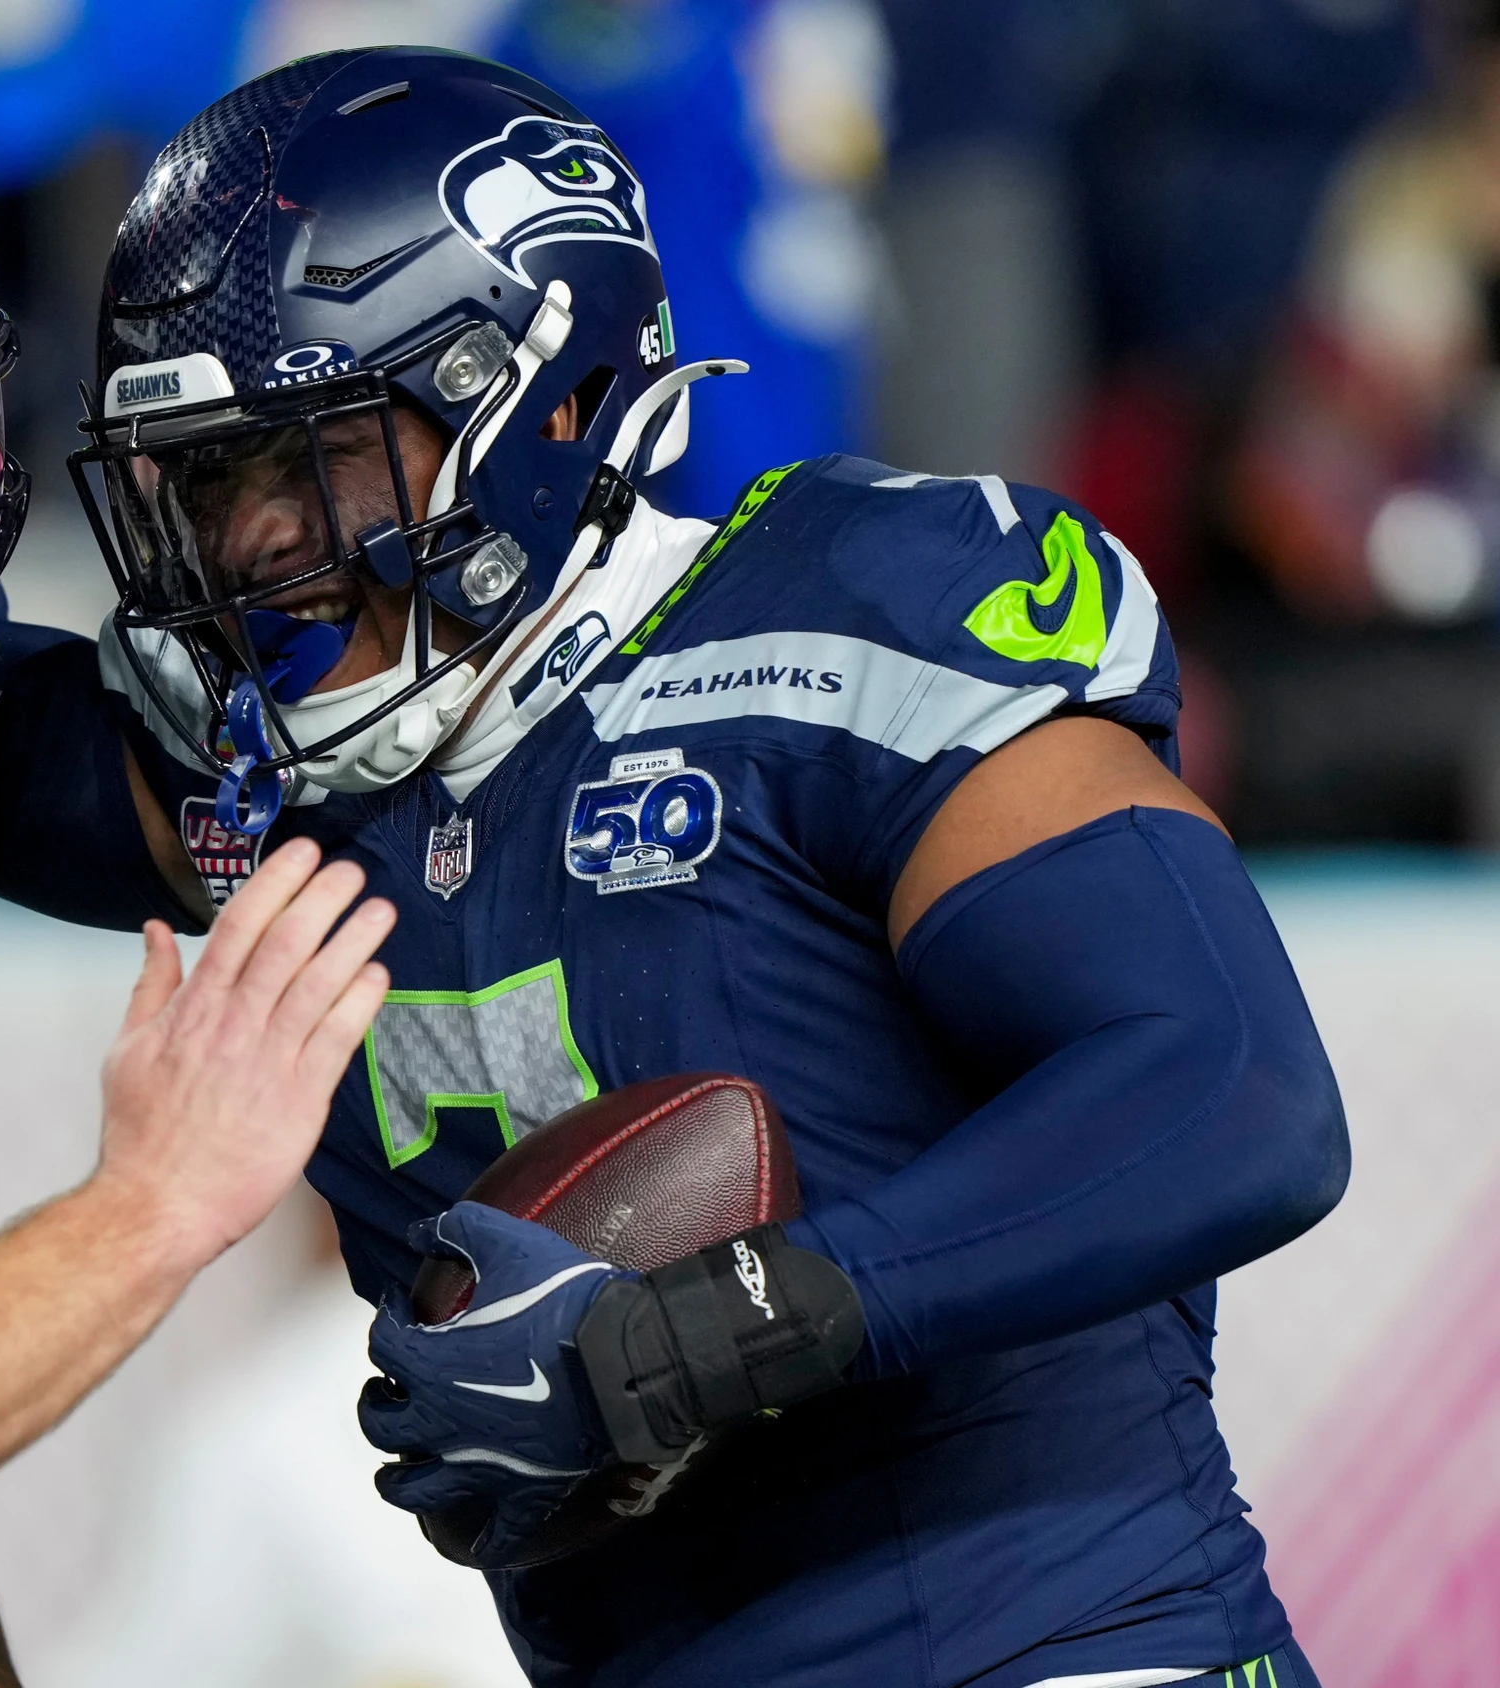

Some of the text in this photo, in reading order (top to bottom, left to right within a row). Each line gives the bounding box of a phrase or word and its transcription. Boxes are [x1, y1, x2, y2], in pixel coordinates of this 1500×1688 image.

[640, 324, 661, 366] 45
[116, 371, 181, 404] SEAHAWKS
[623, 759, 669, 772] EST 1976
[569, 773, 716, 874] 50
[431, 849, 464, 884] NFL
